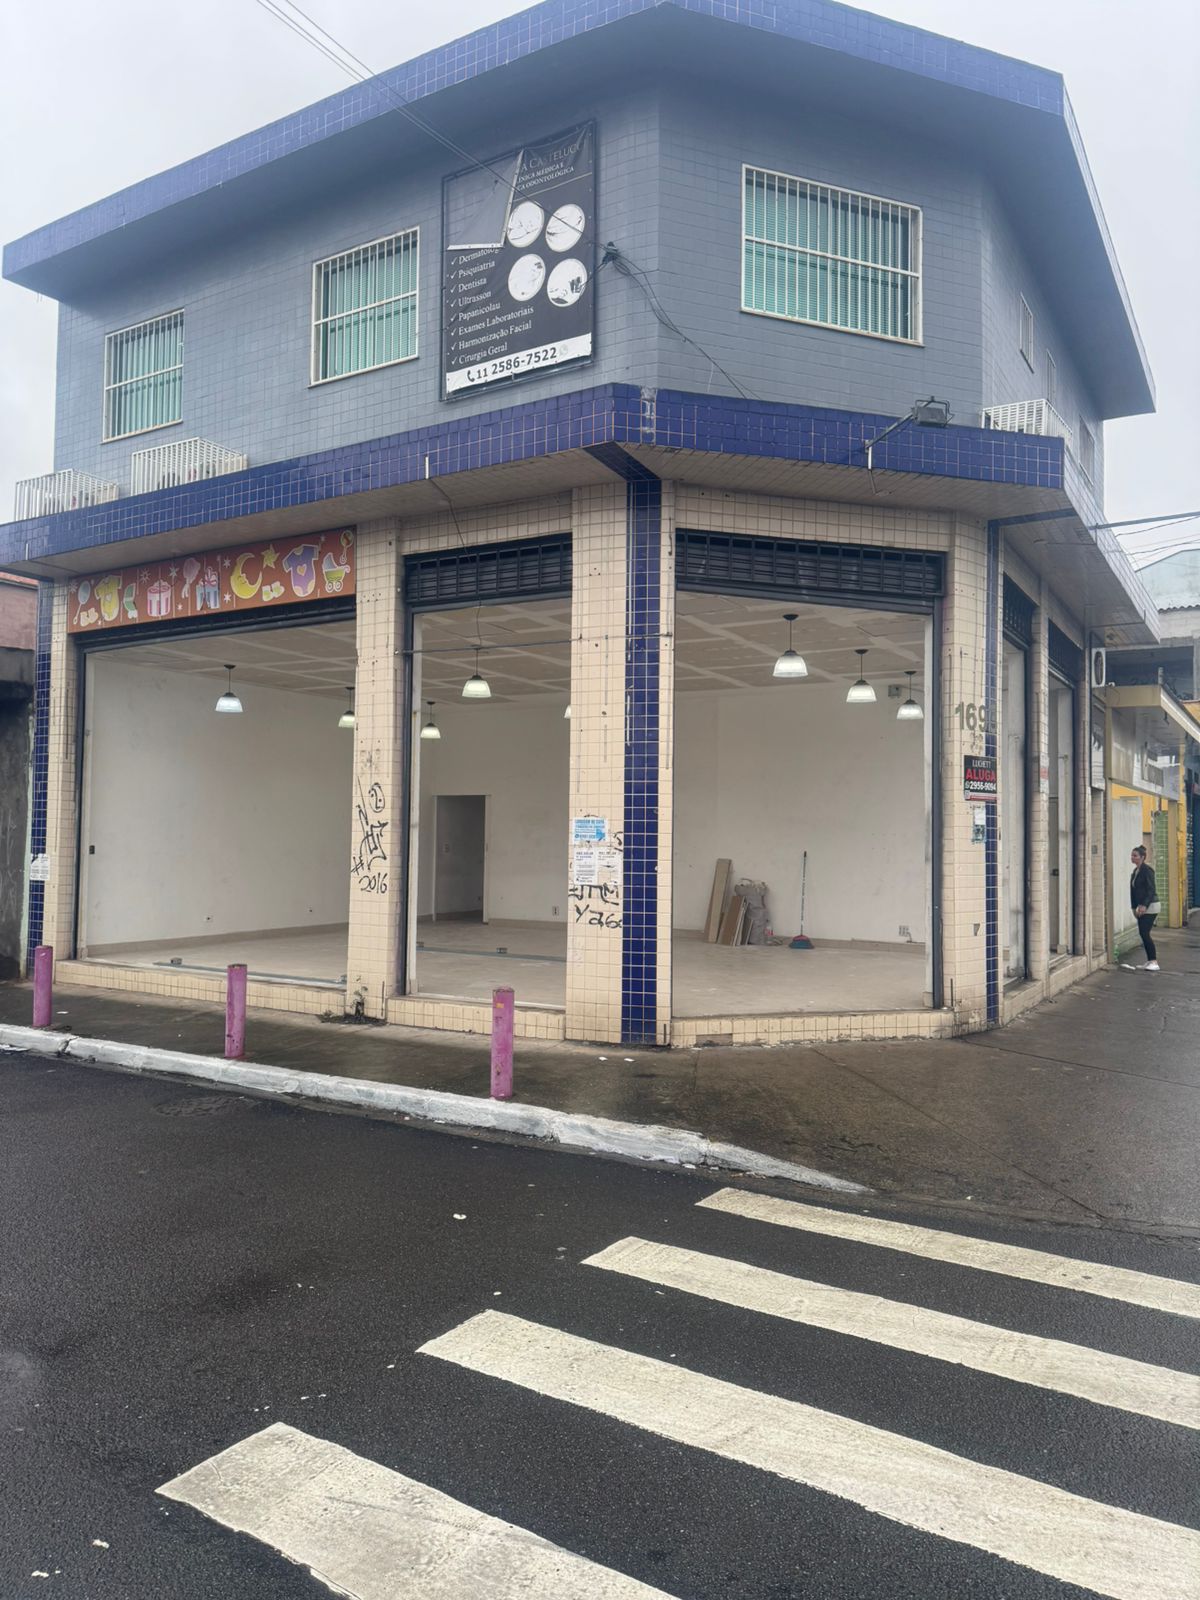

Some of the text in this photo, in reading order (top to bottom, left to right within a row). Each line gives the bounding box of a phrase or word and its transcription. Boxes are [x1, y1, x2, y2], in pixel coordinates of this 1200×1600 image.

[458, 261, 495, 278] Psiquiatria
[458, 278, 487, 292] Dentista
[458, 302, 500, 321] Papanicolau
[458, 305, 534, 335] Exames Laboratoriais
[458, 319, 532, 350] Harmonização Facial
[458, 342, 508, 364] Cirurgia Geral
[476, 346, 557, 380] 11 2586-7522
[965, 767, 996, 782] ALUGA
[358, 872, 388, 894] 2016
